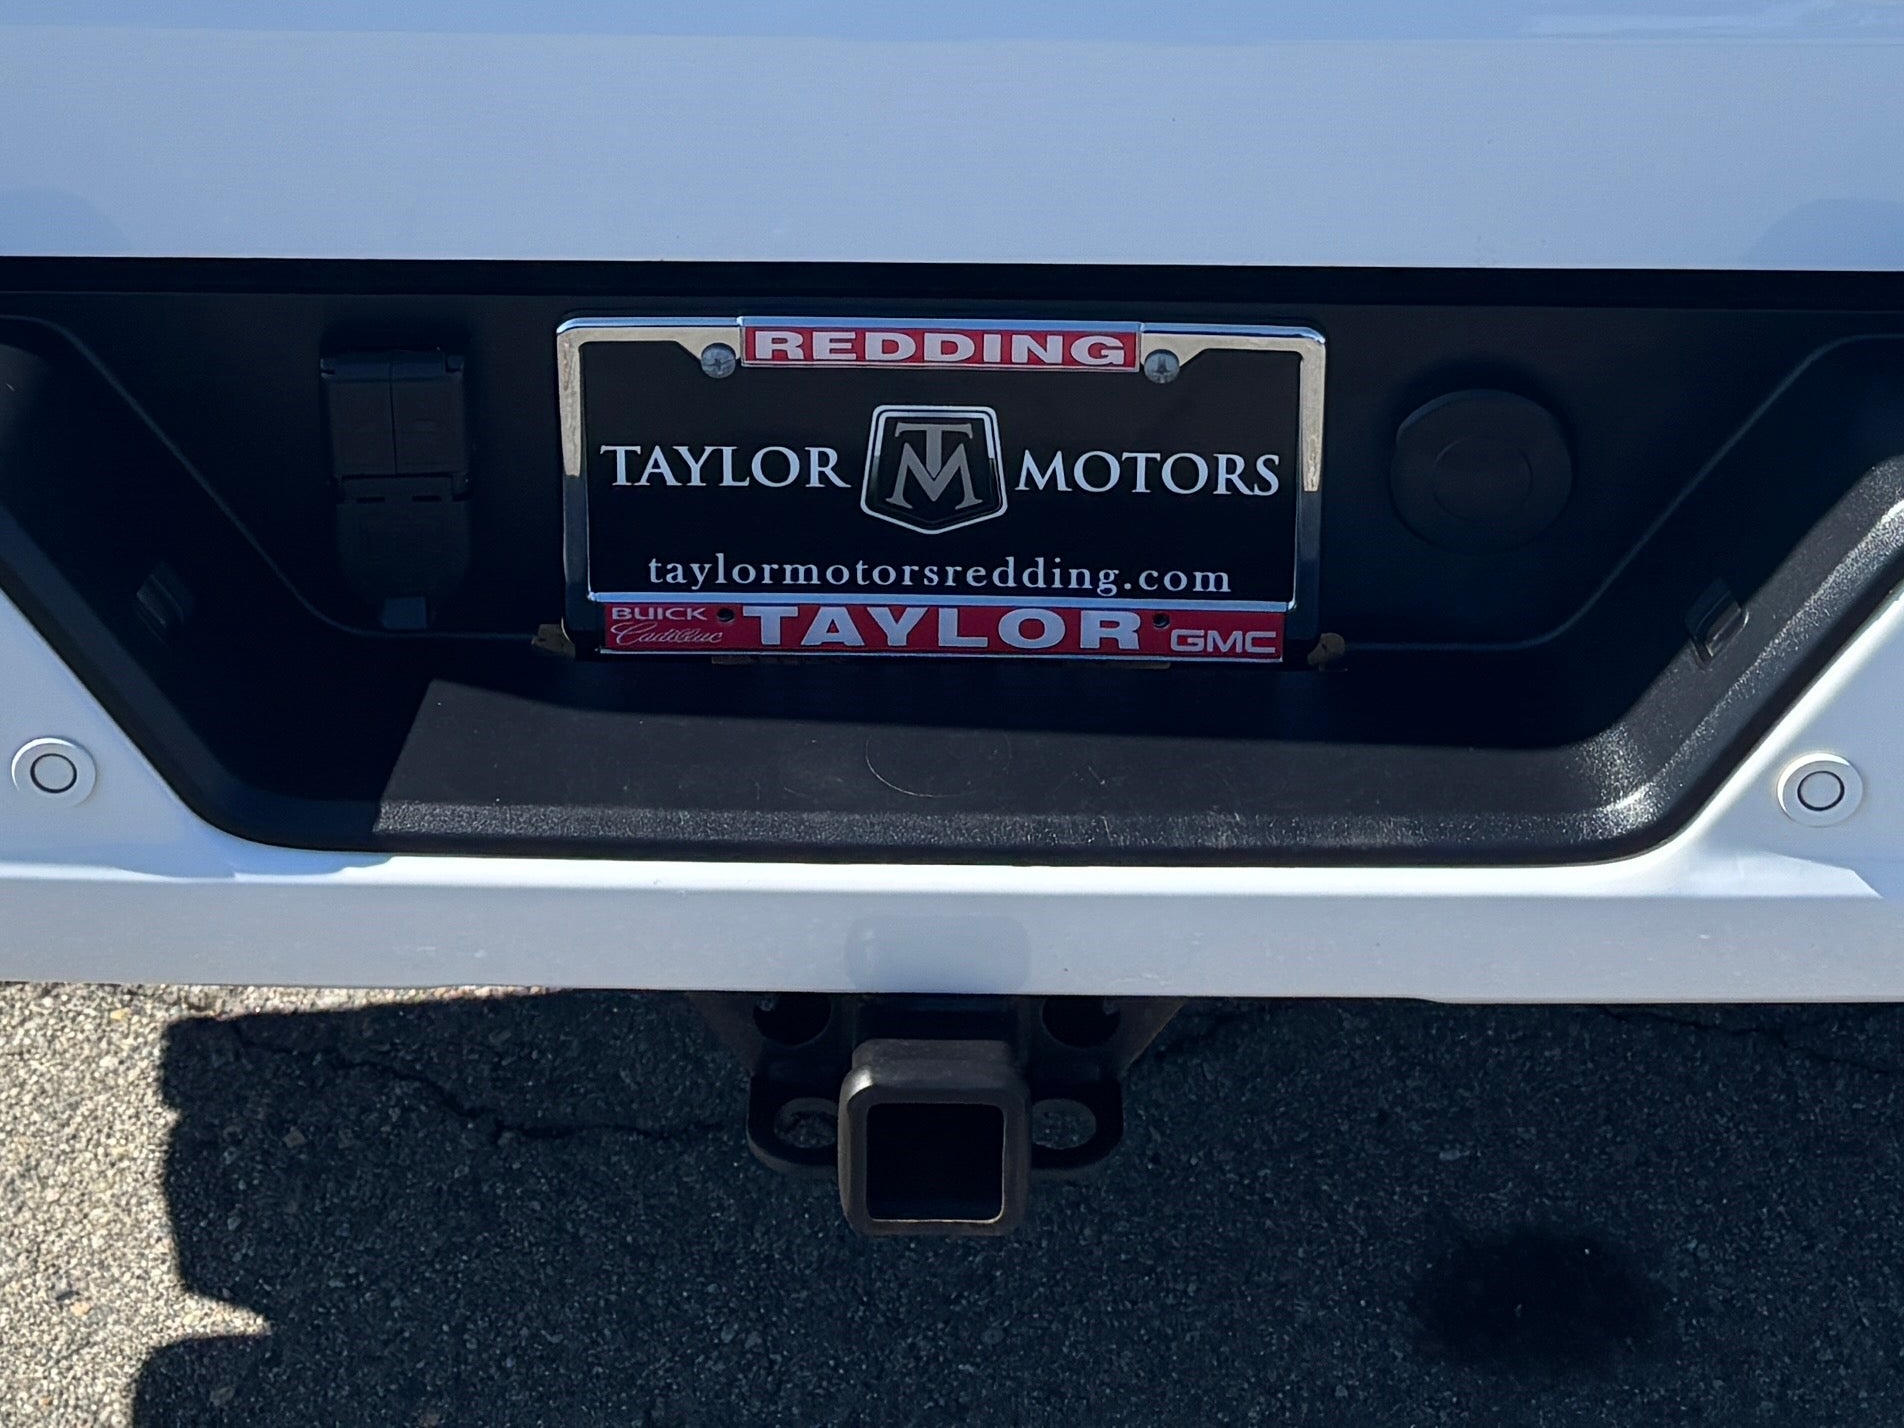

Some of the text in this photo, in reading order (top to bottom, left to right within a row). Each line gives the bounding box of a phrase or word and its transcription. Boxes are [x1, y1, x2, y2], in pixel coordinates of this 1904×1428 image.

[754, 330, 1126, 367] REDDING
[599, 444, 1281, 497] TAYLOR MOTORS
[648, 553, 1233, 597] taylormotorsredding.com
[611, 607, 708, 621] BUICK
[742, 605, 1142, 650] TAYLOR
[1170, 629, 1277, 654] GMC
